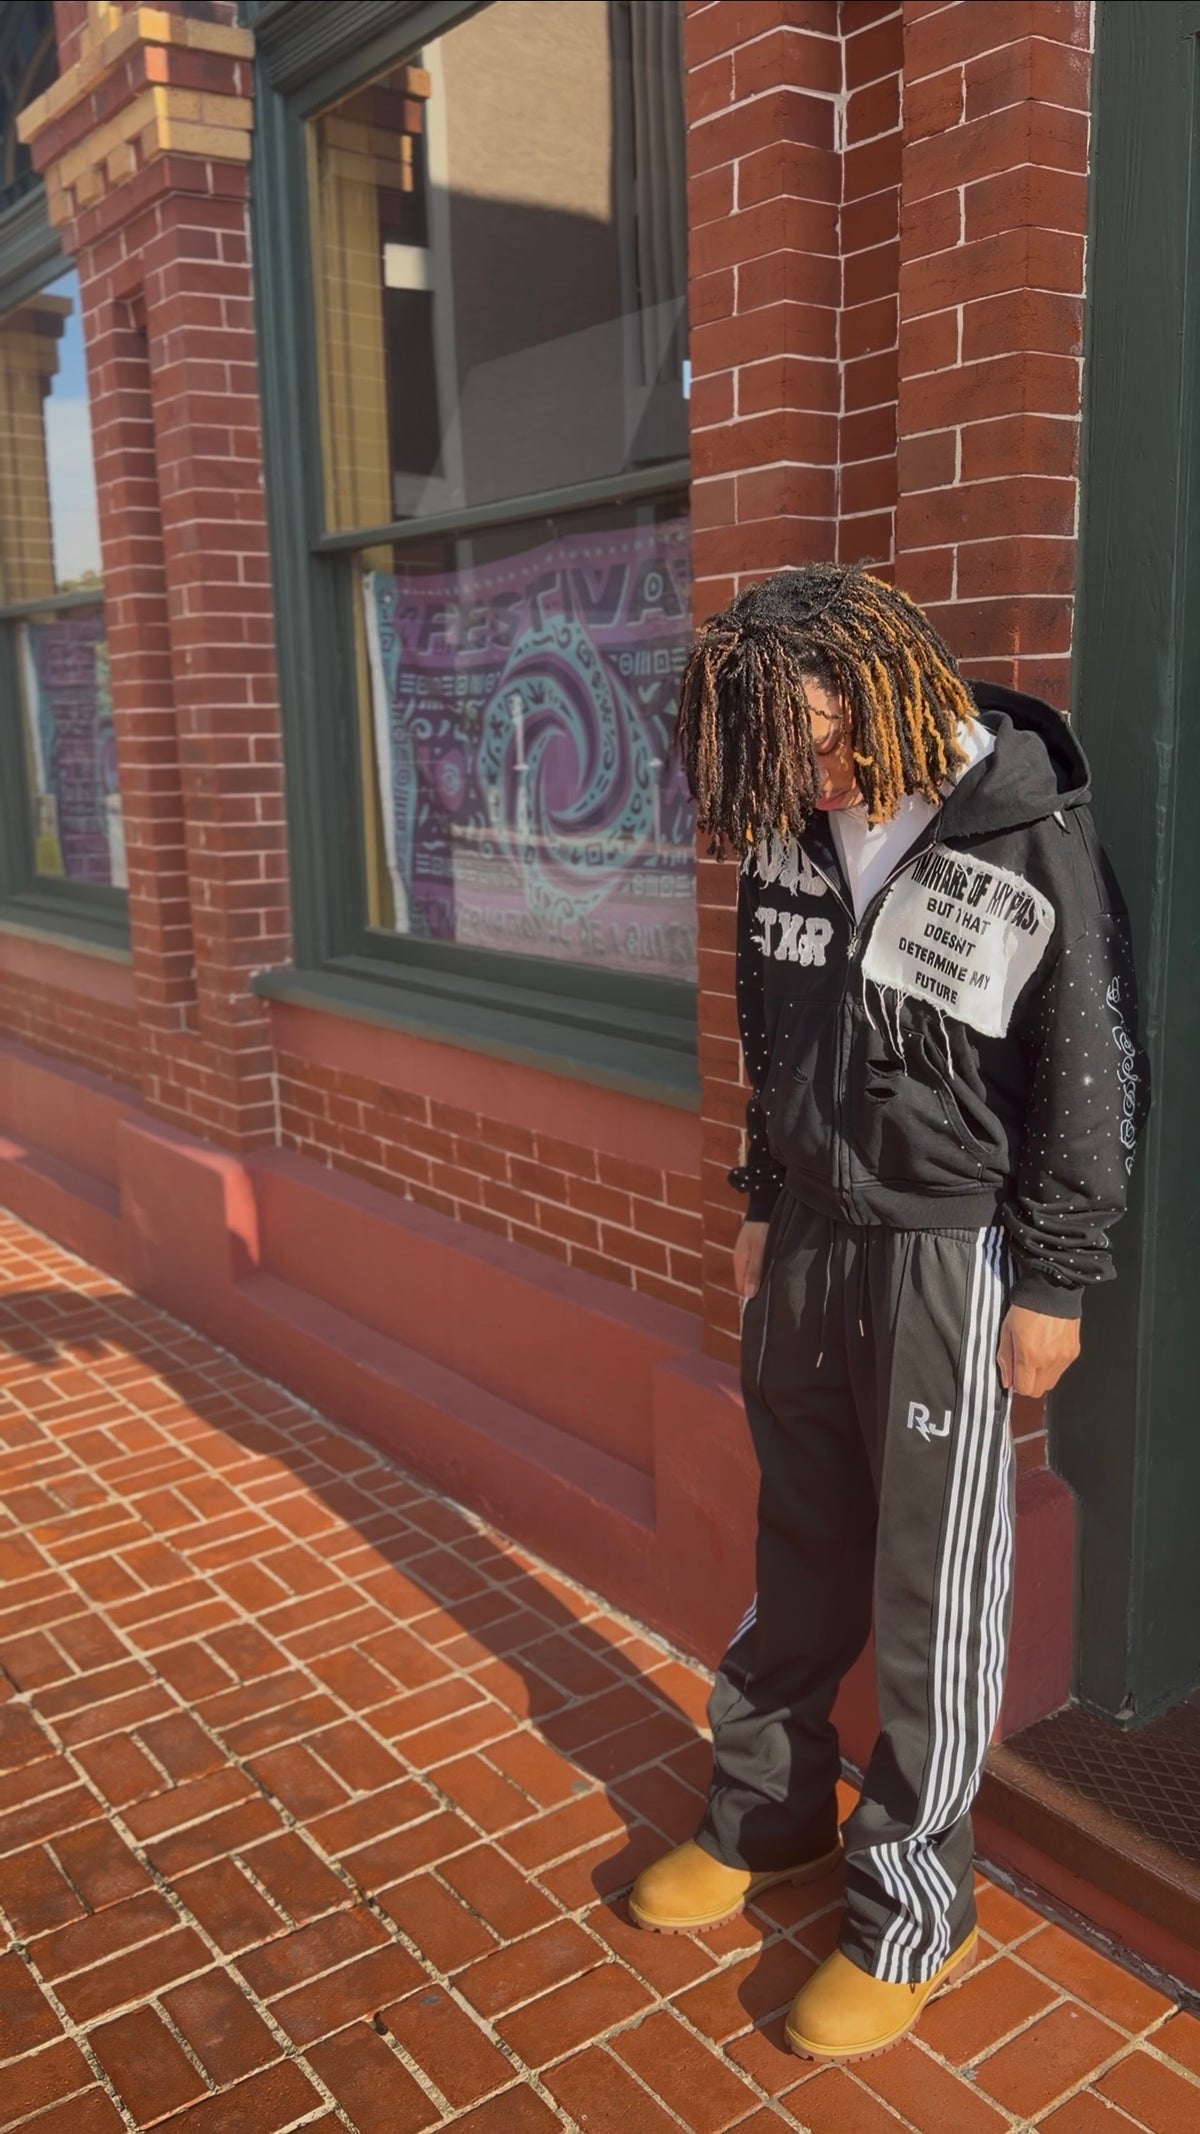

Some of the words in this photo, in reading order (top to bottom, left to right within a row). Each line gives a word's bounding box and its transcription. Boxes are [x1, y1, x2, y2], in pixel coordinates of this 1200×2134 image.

[926, 897, 955, 918] BUT
[955, 908, 991, 936] THAT
[967, 873, 993, 908] OF
[985, 880, 1015, 919] MY
[898, 936, 968, 983] DETERMINE
[968, 970, 991, 991] MY
[915, 971, 959, 1005] FUTURE
[907, 1401, 952, 1442] RJ
